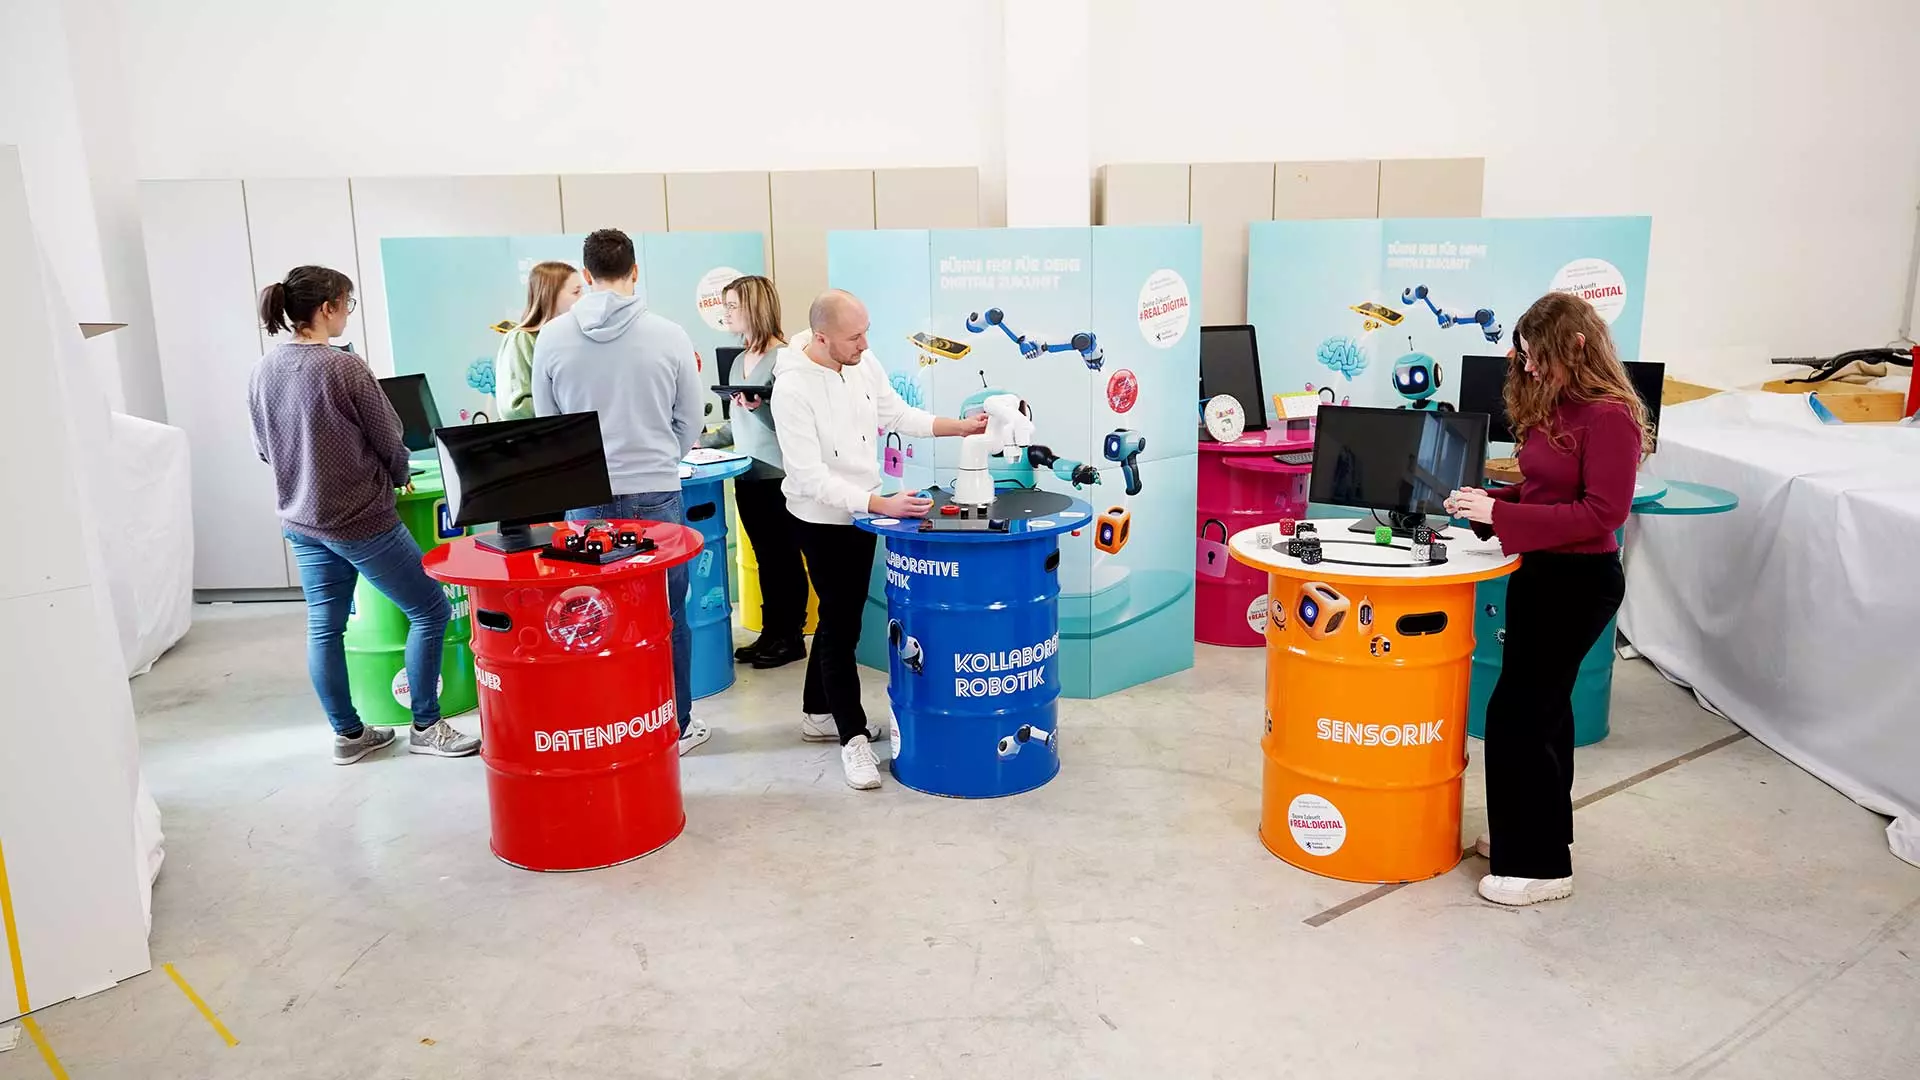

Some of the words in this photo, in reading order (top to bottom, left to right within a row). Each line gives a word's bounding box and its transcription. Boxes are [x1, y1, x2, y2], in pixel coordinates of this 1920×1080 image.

[1139, 296, 1188, 321] #REAL:DIGITAL
[955, 665, 1045, 698] ROBOTIK
[534, 699, 674, 752] DATENPOWER
[1317, 717, 1444, 747] SENSORIK
[1290, 818, 1343, 829] #REAL:DIGITAL
